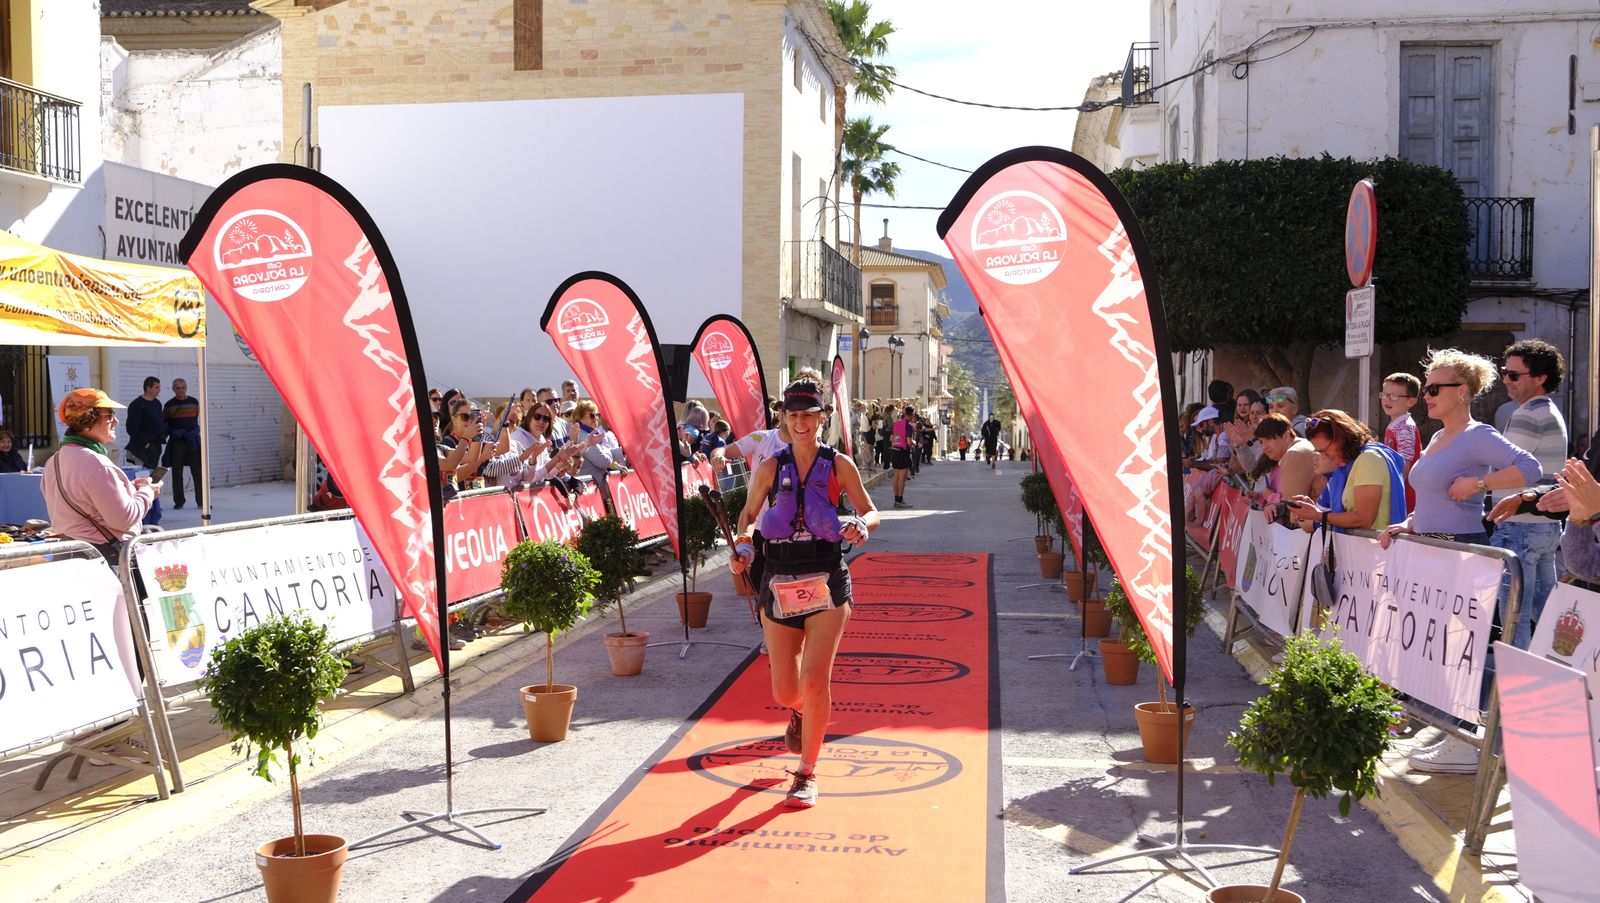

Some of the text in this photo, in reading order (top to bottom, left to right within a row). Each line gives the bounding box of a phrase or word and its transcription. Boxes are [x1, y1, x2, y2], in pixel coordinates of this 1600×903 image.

[115, 196, 198, 231] EXCELENTÍ
[445, 523, 509, 574] VEOLIA
[210, 547, 373, 588] AYUNTAMIENTO DE
[63, 600, 95, 625] DE
[214, 568, 384, 634] CANTORIA
[1452, 594, 1478, 620] DE
[0, 632, 114, 701] RIA
[663, 837, 908, 857] Ayuntamiento
[692, 826, 890, 843] de Cantoria
